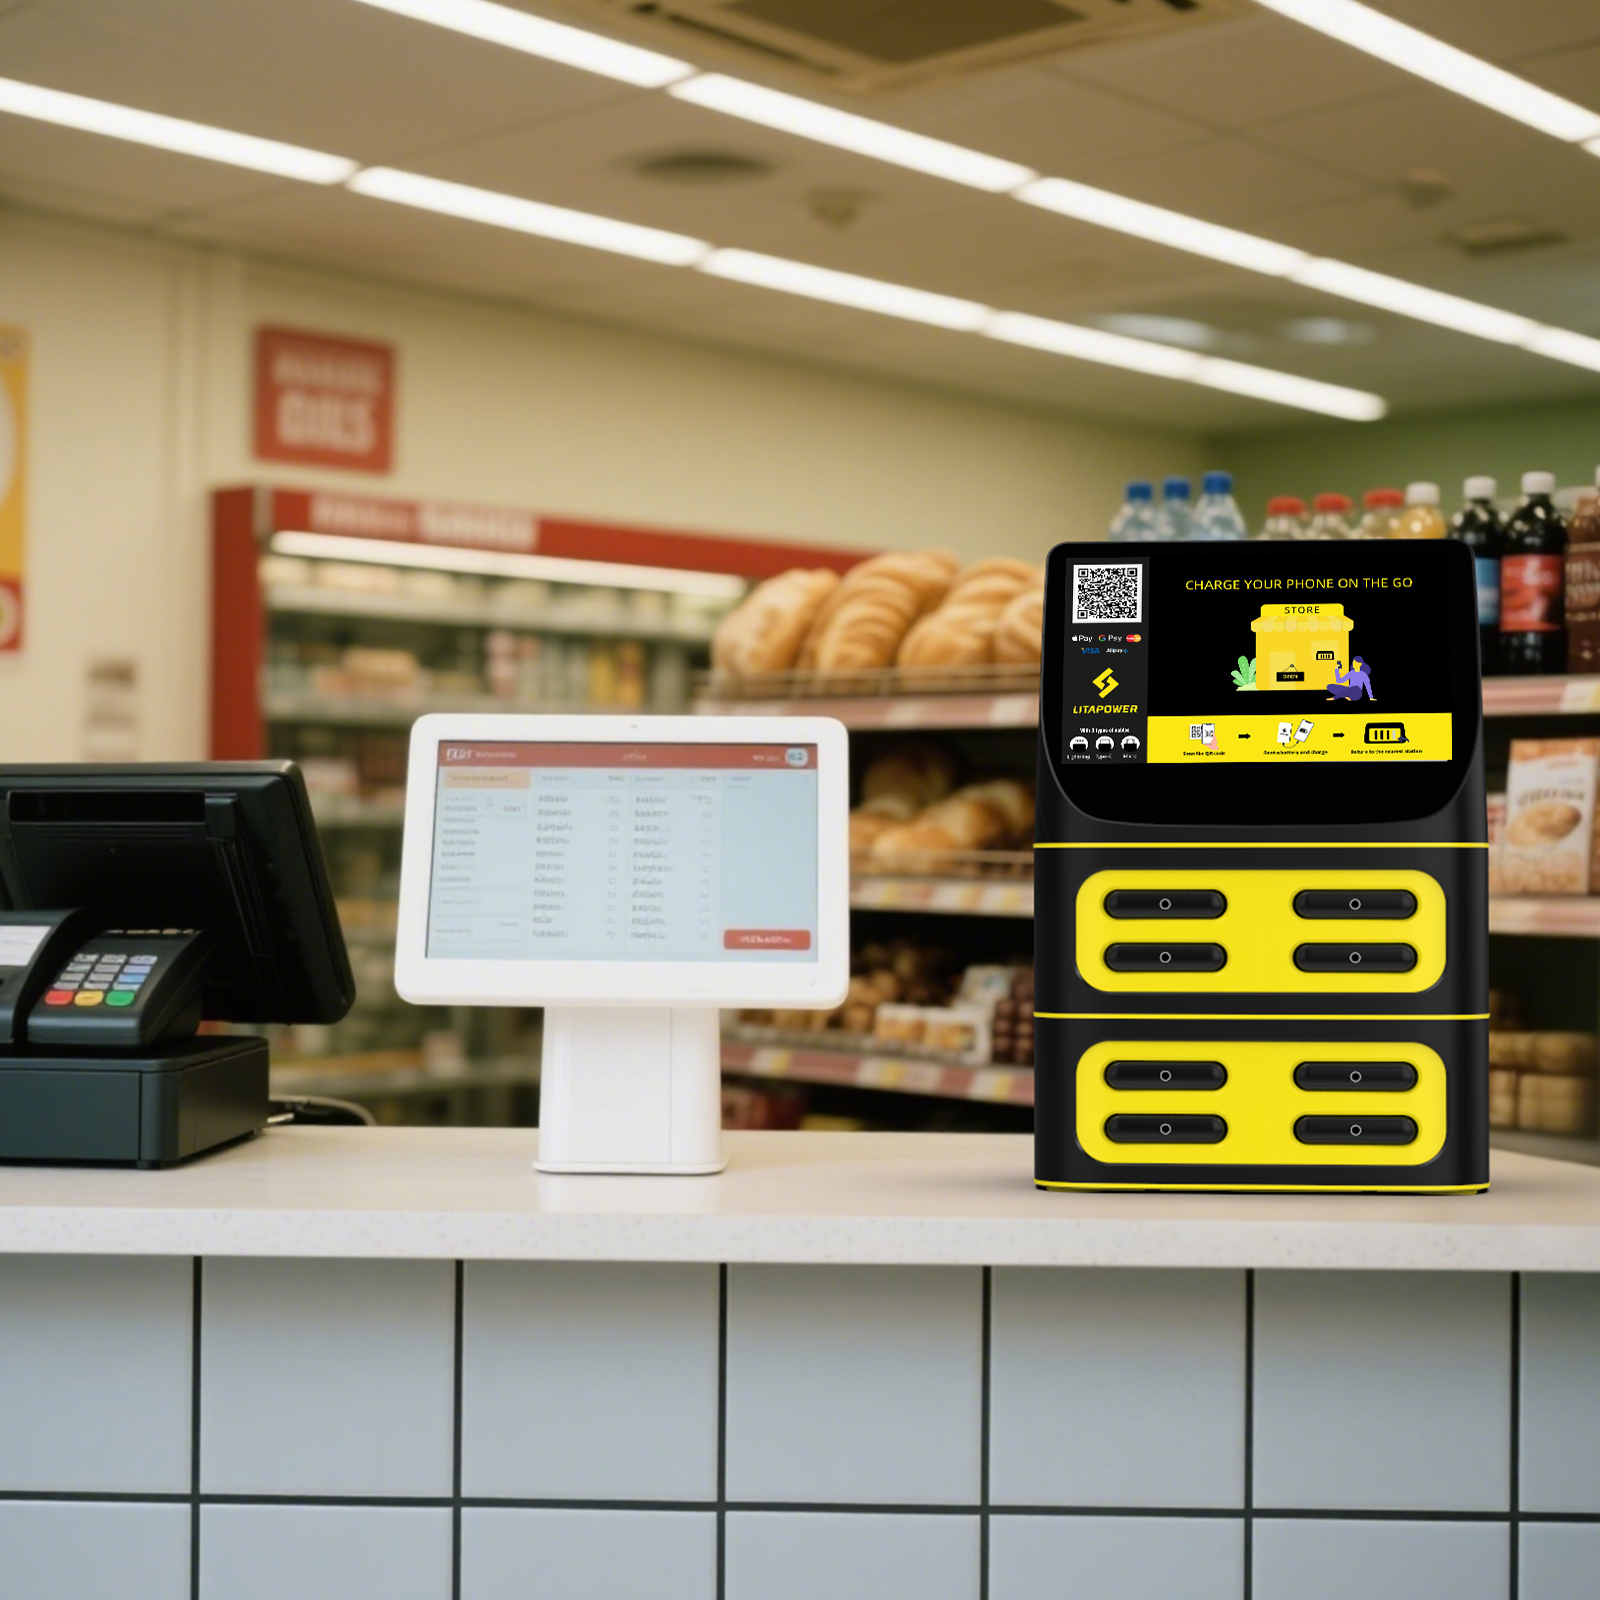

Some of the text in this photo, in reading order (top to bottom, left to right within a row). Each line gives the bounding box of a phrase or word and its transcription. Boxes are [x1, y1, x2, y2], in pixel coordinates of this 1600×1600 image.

[1185, 578, 1412, 590] CHARGE YOUR PHONE ON THE GO
[1284, 606, 1320, 614] STORE
[1078, 634, 1093, 642] Pay
[1072, 704, 1138, 714] LITAPOWER
